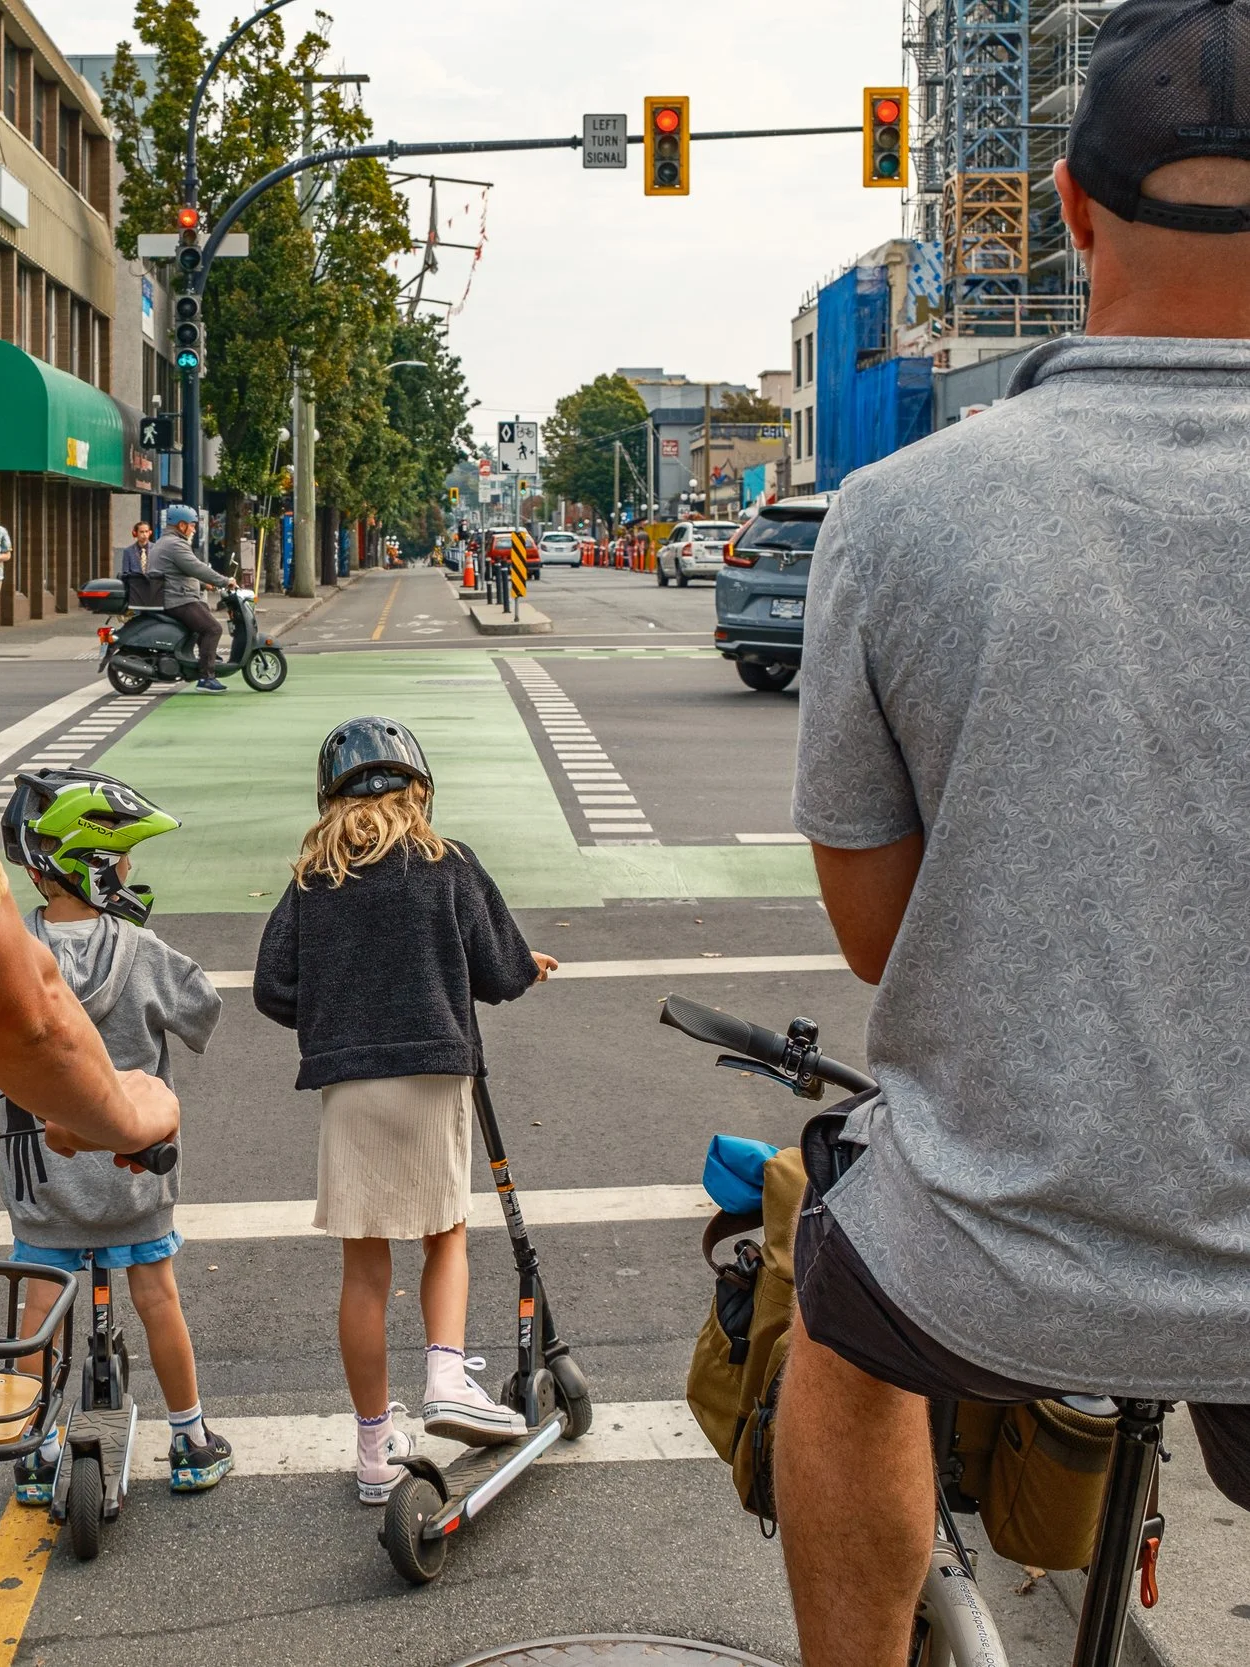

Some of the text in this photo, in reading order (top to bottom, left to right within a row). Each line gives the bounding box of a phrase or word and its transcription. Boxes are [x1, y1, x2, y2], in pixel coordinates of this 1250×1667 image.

[592, 119, 617, 130] LEFT
[591, 135, 618, 147] TURN
[587, 151, 622, 163] SIGNAL
[972, 1608, 990, 1649] Expertise.
